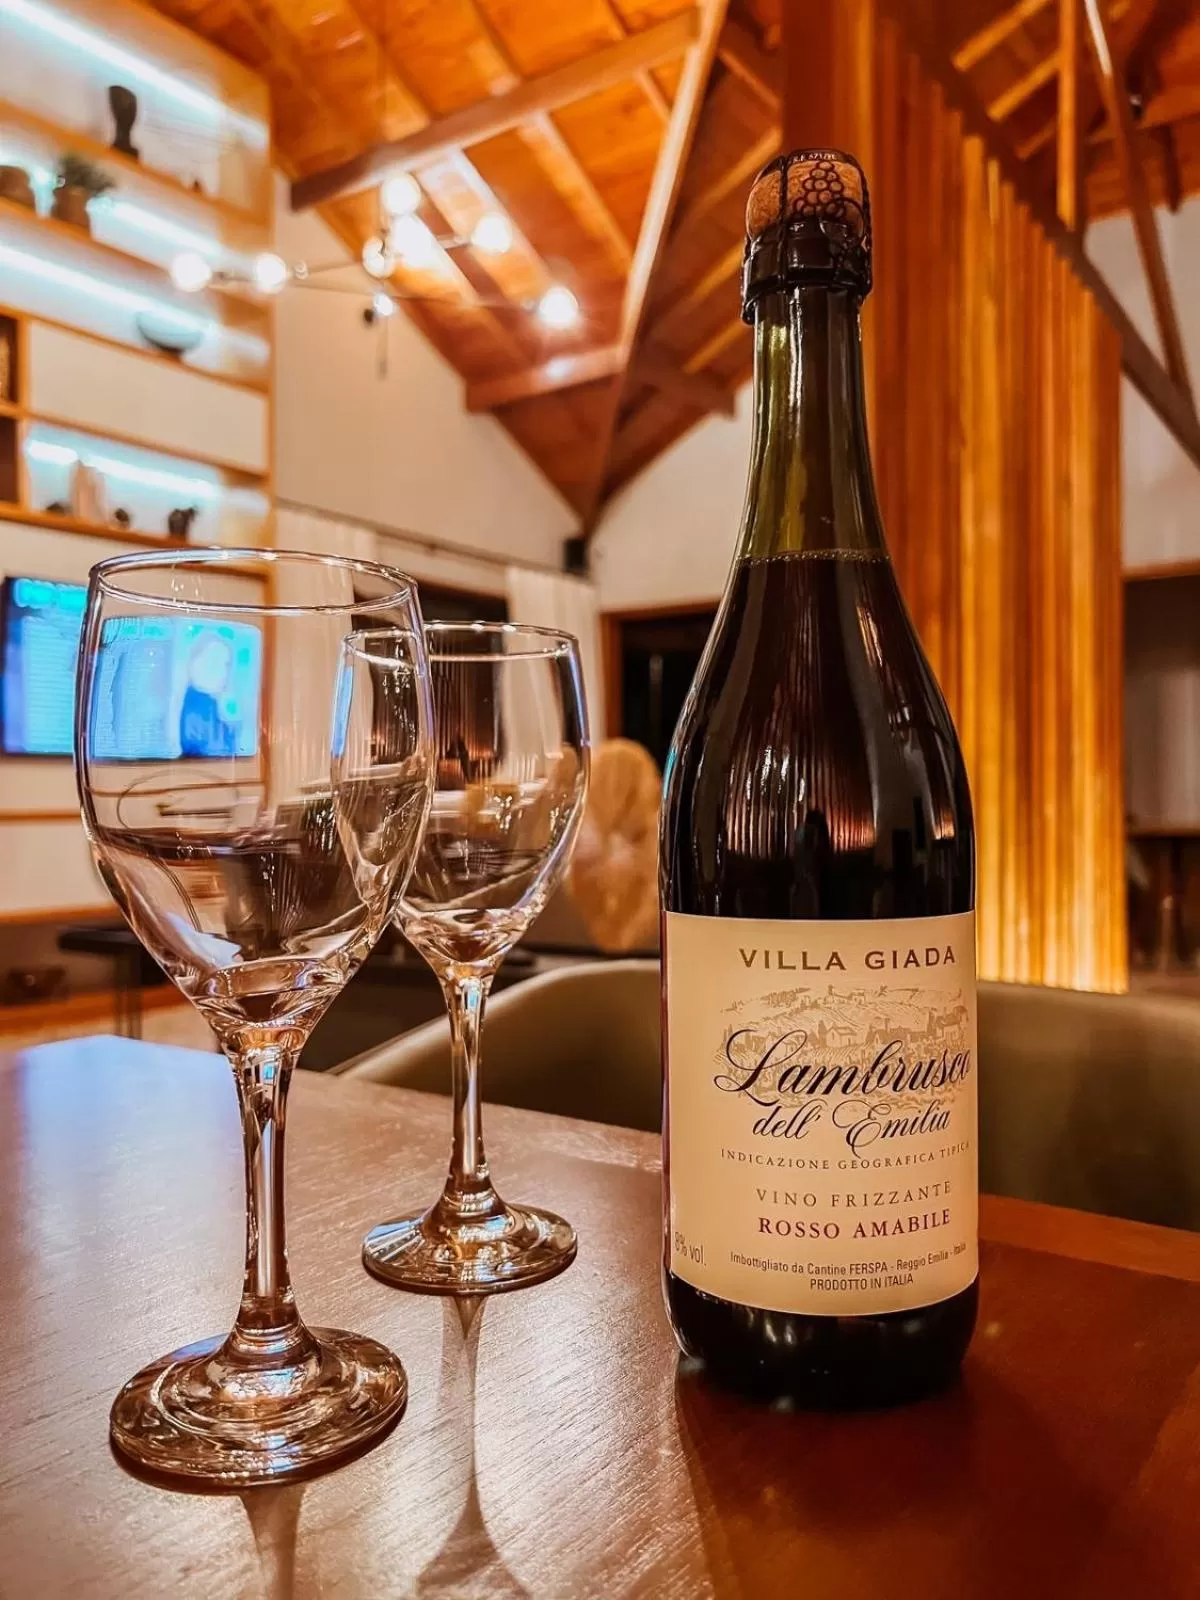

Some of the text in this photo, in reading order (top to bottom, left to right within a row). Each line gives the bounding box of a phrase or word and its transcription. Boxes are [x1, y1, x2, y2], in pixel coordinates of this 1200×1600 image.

[739, 945, 956, 971] VILLA GIADA
[752, 1097, 951, 1159] dell' Emilia
[720, 1148, 830, 1170] INDICAZIONE
[837, 1152, 935, 1171] GEOGRAFICA
[756, 1180, 952, 1208] VINO FRIZZANTE
[758, 1208, 952, 1240] ROSSO AMABILE
[689, 1245, 707, 1267] vol.
[730, 1251, 789, 1273] Imbottigliato
[791, 1262, 804, 1274] da
[807, 1262, 847, 1276] Cantine
[849, 1261, 888, 1275] FERSPA
[896, 1258, 926, 1272] Reggio
[927, 1251, 949, 1265] Emilia
[810, 1273, 914, 1291] PRODOTTO IN ITALIA
